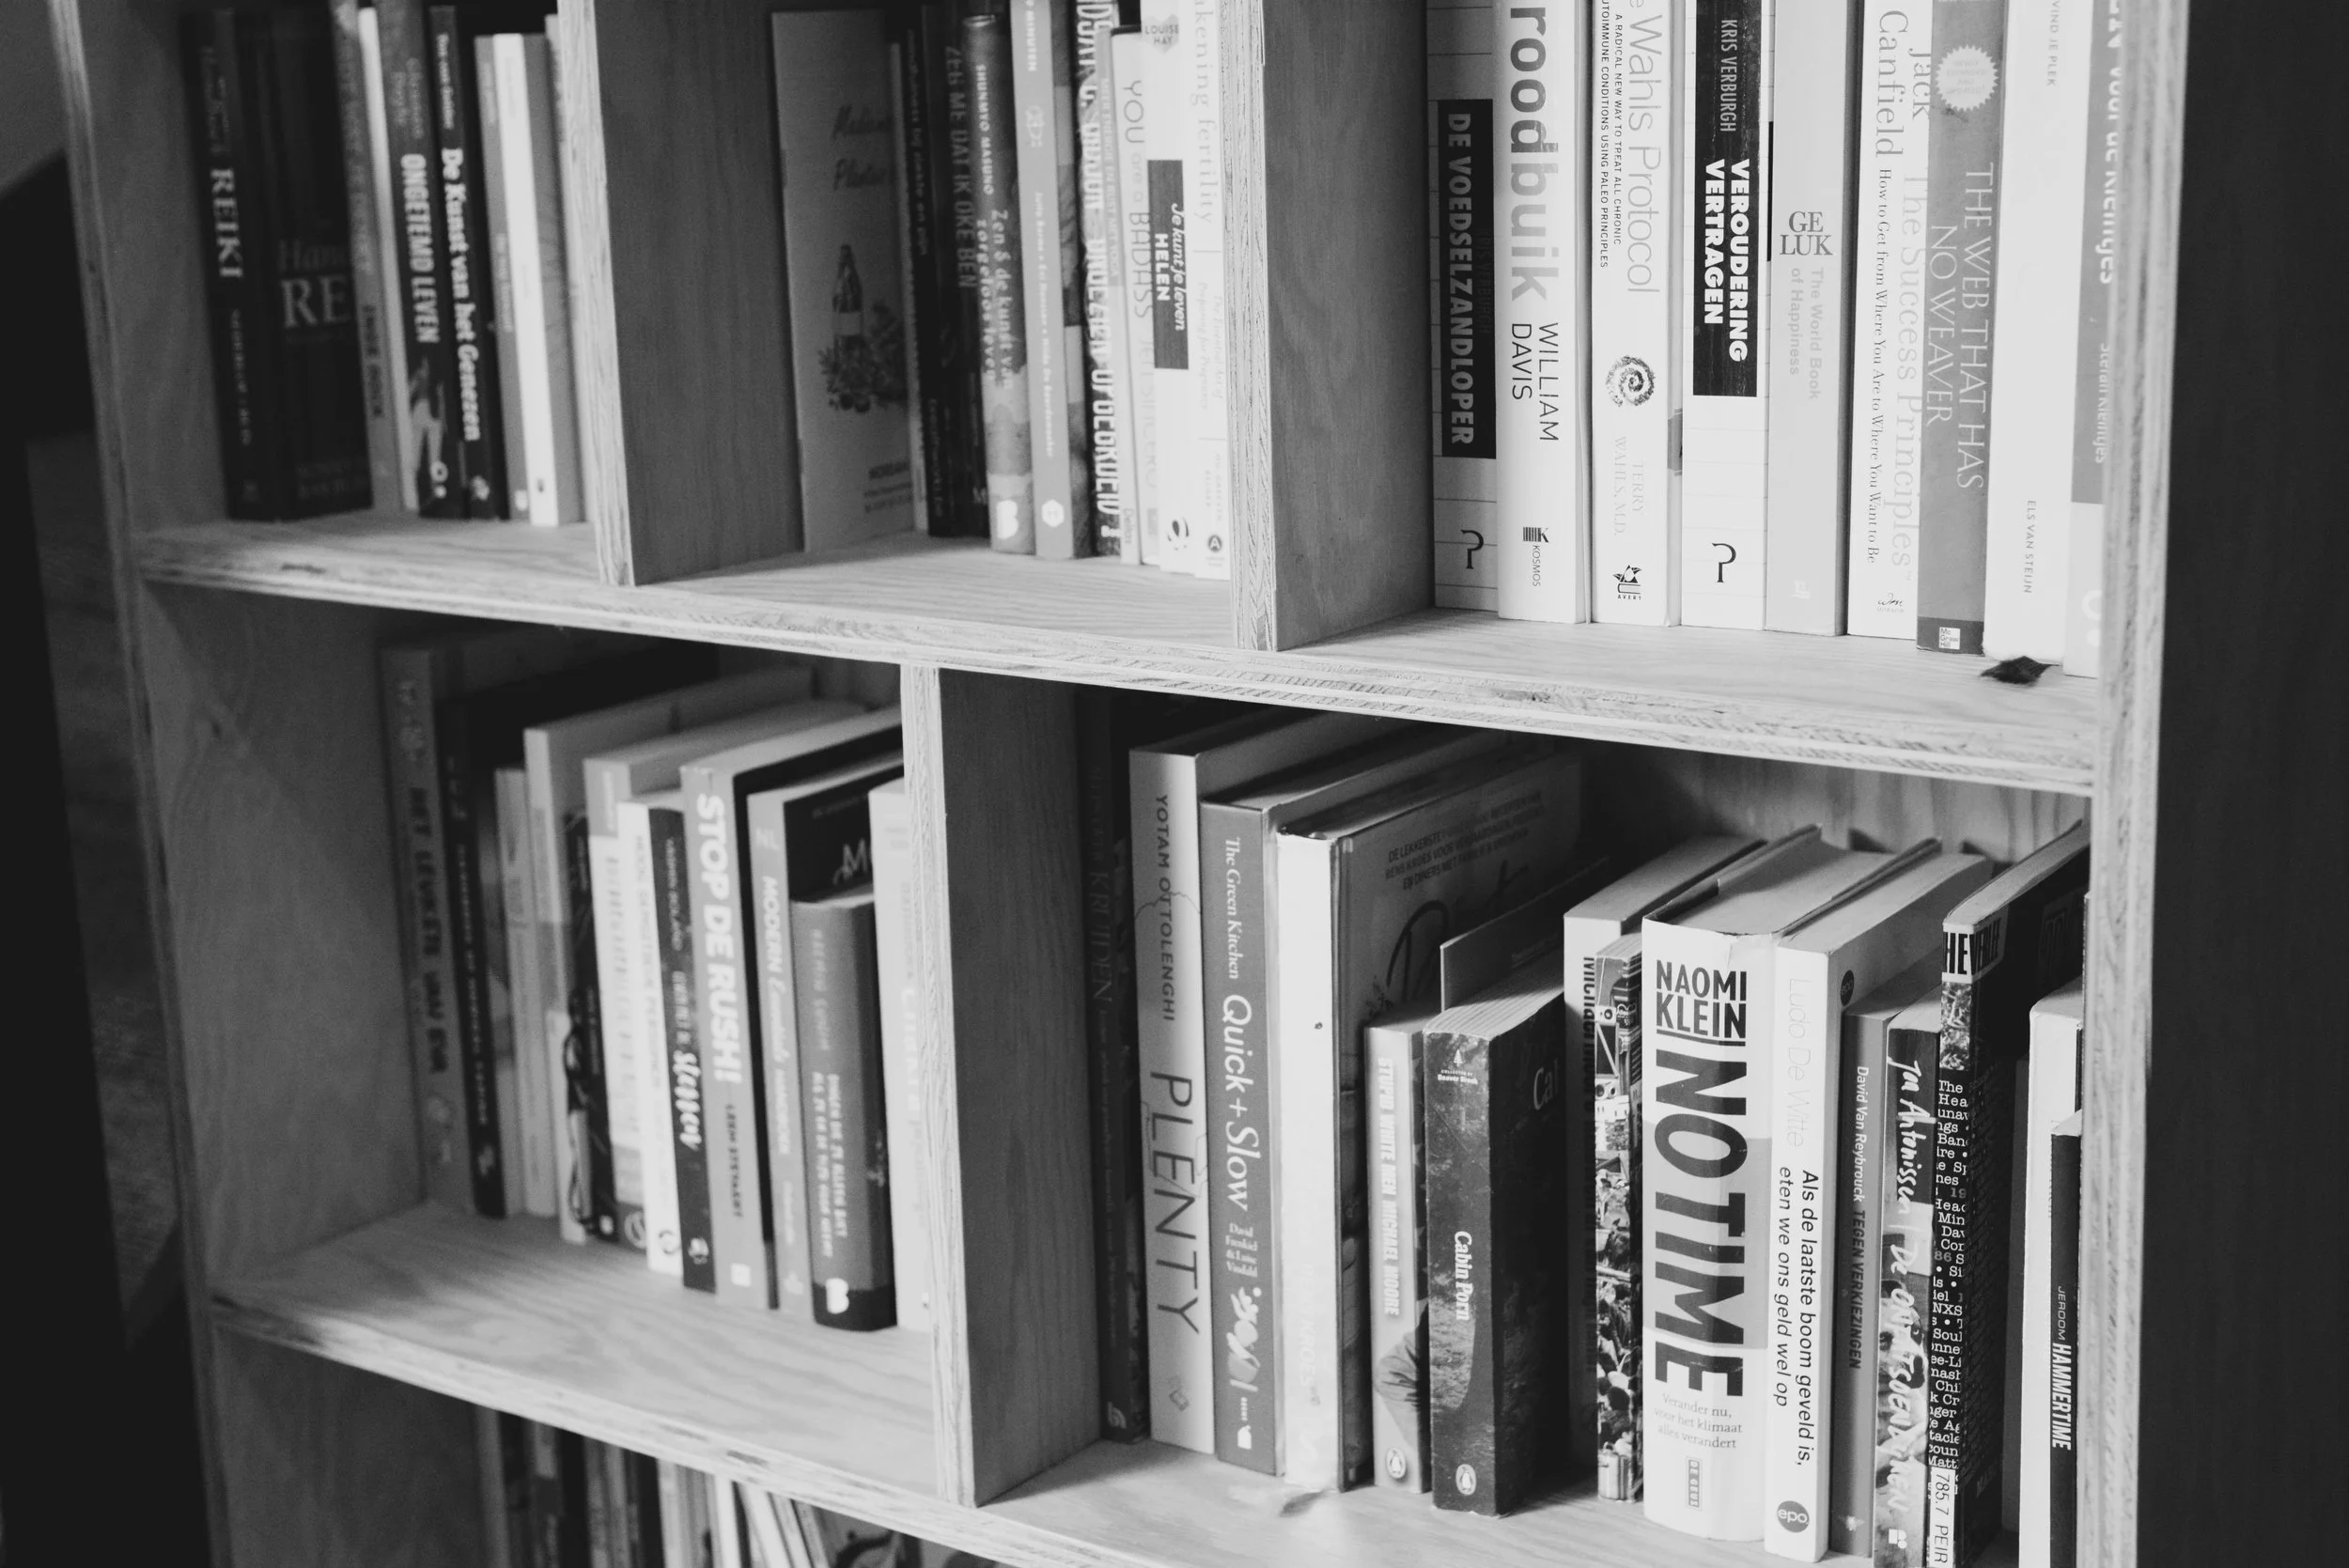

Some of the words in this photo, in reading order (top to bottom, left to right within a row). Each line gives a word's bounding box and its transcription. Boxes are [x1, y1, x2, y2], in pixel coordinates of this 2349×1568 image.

[1144, 24, 1179, 35] LOUISE
[1720, 19, 1737, 53] KRIS
[2050, 0, 2061, 34] VIND
[1153, 36, 1173, 45] HAY
[1614, 24, 1624, 69] RADICAL
[2049, 39, 2060, 52] JE
[1614, 73, 1624, 97] NEW
[1628, 14, 1663, 132] Wahls
[1876, 9, 1909, 158] Canfield
[1907, 48, 1932, 121] Jack
[2046, 54, 2058, 86] PLEK
[1123, 80, 1145, 145] YOU
[1601, 66, 1610, 132] CONDITIONS
[1614, 100, 1624, 121] WAY
[1720, 55, 1737, 132] VERBURGH
[1448, 114, 1471, 147] DE
[1601, 134, 1610, 168] USING
[1614, 124, 1624, 137] TO
[440, 148, 464, 179] De
[982, 136, 994, 195] MASUNO
[1193, 116, 1219, 225] fertility
[1510, 6, 1559, 302] roodbuik
[1614, 141, 1623, 172] TREAT
[1600, 171, 1609, 204] PALEO
[1613, 176, 1623, 195] ALL
[1879, 168, 1892, 203] How
[1904, 173, 1930, 236] The
[1963, 162, 1994, 228] THE
[210, 169, 243, 280] REIKI
[443, 182, 472, 255] Kunst
[992, 210, 1011, 245] Zen
[1170, 203, 1185, 229] Je
[1613, 198, 1623, 245] CHRONIC
[1627, 147, 1662, 292] Protocol
[1788, 211, 1825, 233] GE
[1876, 221, 1891, 246] Get
[1878, 204, 1891, 218] to
[993, 250, 1013, 264] &
[1171, 229, 1187, 266] kunt
[1600, 207, 1609, 268] PRINCIPLES
[1704, 159, 1725, 323] VERTRAGEN
[1780, 233, 1834, 256] LUK
[1929, 225, 1958, 279] NO
[450, 256, 472, 300] van
[973, 219, 995, 321] zorgeloos
[996, 268, 1014, 291] de
[1155, 234, 1171, 301] HELEN
[1168, 267, 1187, 287] je
[1729, 159, 1750, 362] VEROUDERING
[1789, 267, 1804, 287] of
[1809, 268, 1824, 298] The
[1875, 250, 1890, 287] from
[1961, 235, 1992, 310] WEB
[413, 276, 440, 344] LEVEN
[996, 295, 1015, 349] kunst
[1173, 287, 1189, 332] leven
[1449, 156, 1474, 444] VOEDSELZANDLOPER
[1875, 289, 1890, 336] Where
[1897, 246, 1927, 380] Success
[453, 303, 477, 345] het
[1788, 289, 1804, 376] Happiness
[1809, 304, 1823, 352] World
[1000, 357, 1016, 389] van
[1511, 322, 1532, 401] DAVIS
[1873, 339, 1887, 365] You
[1926, 287, 1956, 427] WEAVER
[1959, 318, 1989, 413] THAT
[457, 345, 480, 442] Genezen
[1539, 322, 1559, 442] WILLIAM
[1809, 357, 1823, 400] Book
[1872, 367, 1886, 395] Are
[1872, 397, 1884, 411] to
[1871, 414, 1885, 461] Where
[1957, 422, 1985, 489] HAS
[1631, 459, 1644, 514] TERRY
[1869, 463, 1883, 489] You
[1883, 395, 1921, 567] Principles
[1613, 503, 1626, 536] M.D.
[1868, 491, 1882, 526] Want
[2028, 500, 2037, 520] ELS
[1867, 546, 1879, 564] Be
[1868, 529, 1881, 543] to
[2026, 524, 2036, 550] VAN
[1532, 545, 1541, 587] KOSMOS
[2024, 553, 2034, 594] STEIJN
[1940, 628, 1952, 636] Mc
[697, 793, 732, 900] STOP
[1156, 795, 1171, 869] YOTAM
[1225, 836, 1240, 866] The
[1225, 869, 1240, 917] Green
[703, 903, 734, 957] DE
[762, 876, 783, 972] MODERN
[1090, 869, 1114, 1002] KRUIDEN
[1158, 877, 1175, 1021] OTTOLENGHI
[1225, 920, 1244, 980] Kitchen
[1656, 958, 1748, 1001] NAOMI
[708, 963, 743, 1084] RUSH!
[1656, 991, 1747, 1039] KLEIN
[1787, 977, 1812, 1039] Ludo
[1221, 994, 1254, 1094] Quick
[1787, 1046, 1812, 1081] De
[1378, 1057, 1394, 1110] STUPID
[1856, 1066, 1870, 1103] David
[1887, 1056, 1922, 1092] Jan
[1938, 1079, 1964, 1094] The
[1379, 1113, 1396, 1162] WHITE
[1785, 1089, 1811, 1147] Witte
[1855, 1106, 1869, 1130] Van
[1225, 1121, 1261, 1213] Slow
[1853, 1133, 1868, 1203] Reybrouck
[1895, 1097, 1935, 1214] Antonissen
[1149, 1070, 1201, 1334] PLENTY
[1380, 1163, 1396, 1196] MEN
[1777, 1165, 1794, 1210] eten
[1801, 1169, 1819, 1202] Als
[1382, 1200, 1398, 1261] MICHAEL
[1777, 1217, 1791, 1246] we
[1800, 1207, 1818, 1233] de
[1851, 1209, 1867, 1257] TEGEN
[1454, 1231, 1473, 1281] Cabin
[1777, 1251, 1792, 1288] ons
[1799, 1238, 1818, 1306] laatste
[1384, 1265, 1400, 1316] MOORE
[1454, 1281, 1474, 1320] Porn
[1773, 1294, 1793, 1337] geld
[1847, 1262, 1865, 1370] VERKIEZINGEN
[2057, 1285, 2067, 1342] JEROOM
[1775, 1342, 1792, 1376] wel
[1798, 1312, 1817, 1369] boom
[1661, 1393, 1709, 1415] Verander
[1711, 1407, 1732, 1419] nu,
[1772, 1381, 1789, 1407] op
[1794, 1374, 1815, 1440] geveld
[2051, 1342, 2073, 1452] HAMMERTIME
[1654, 1407, 1674, 1421] voor
[1678, 1412, 1694, 1427] het
[1697, 1418, 1743, 1434] klimaat
[1657, 1423, 1680, 1439] alles
[1681, 1433, 1736, 1449] verandert
[1796, 1444, 1814, 1467] is,
[1778, 1508, 1808, 1524] epo
[1935, 1473, 1952, 1516] 785.7
[1934, 1524, 1950, 1563] PEIR
